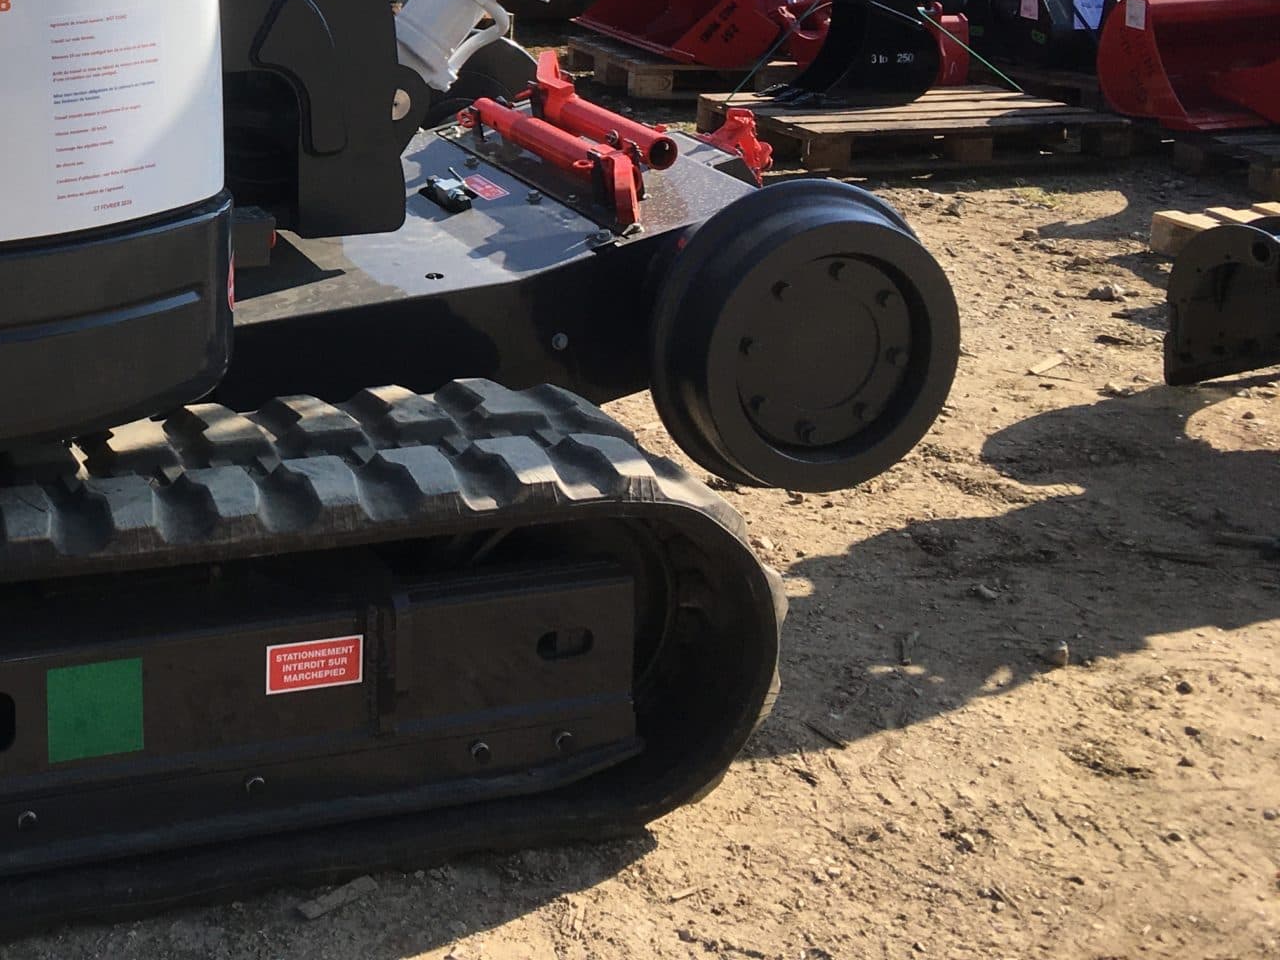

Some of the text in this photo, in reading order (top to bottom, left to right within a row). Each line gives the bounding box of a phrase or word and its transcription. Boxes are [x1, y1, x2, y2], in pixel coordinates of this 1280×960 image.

[275, 645, 355, 662] STATIONNEMENT
[282, 656, 348, 672] INTERDIT SUR
[283, 667, 346, 683] MARCHEPIED
